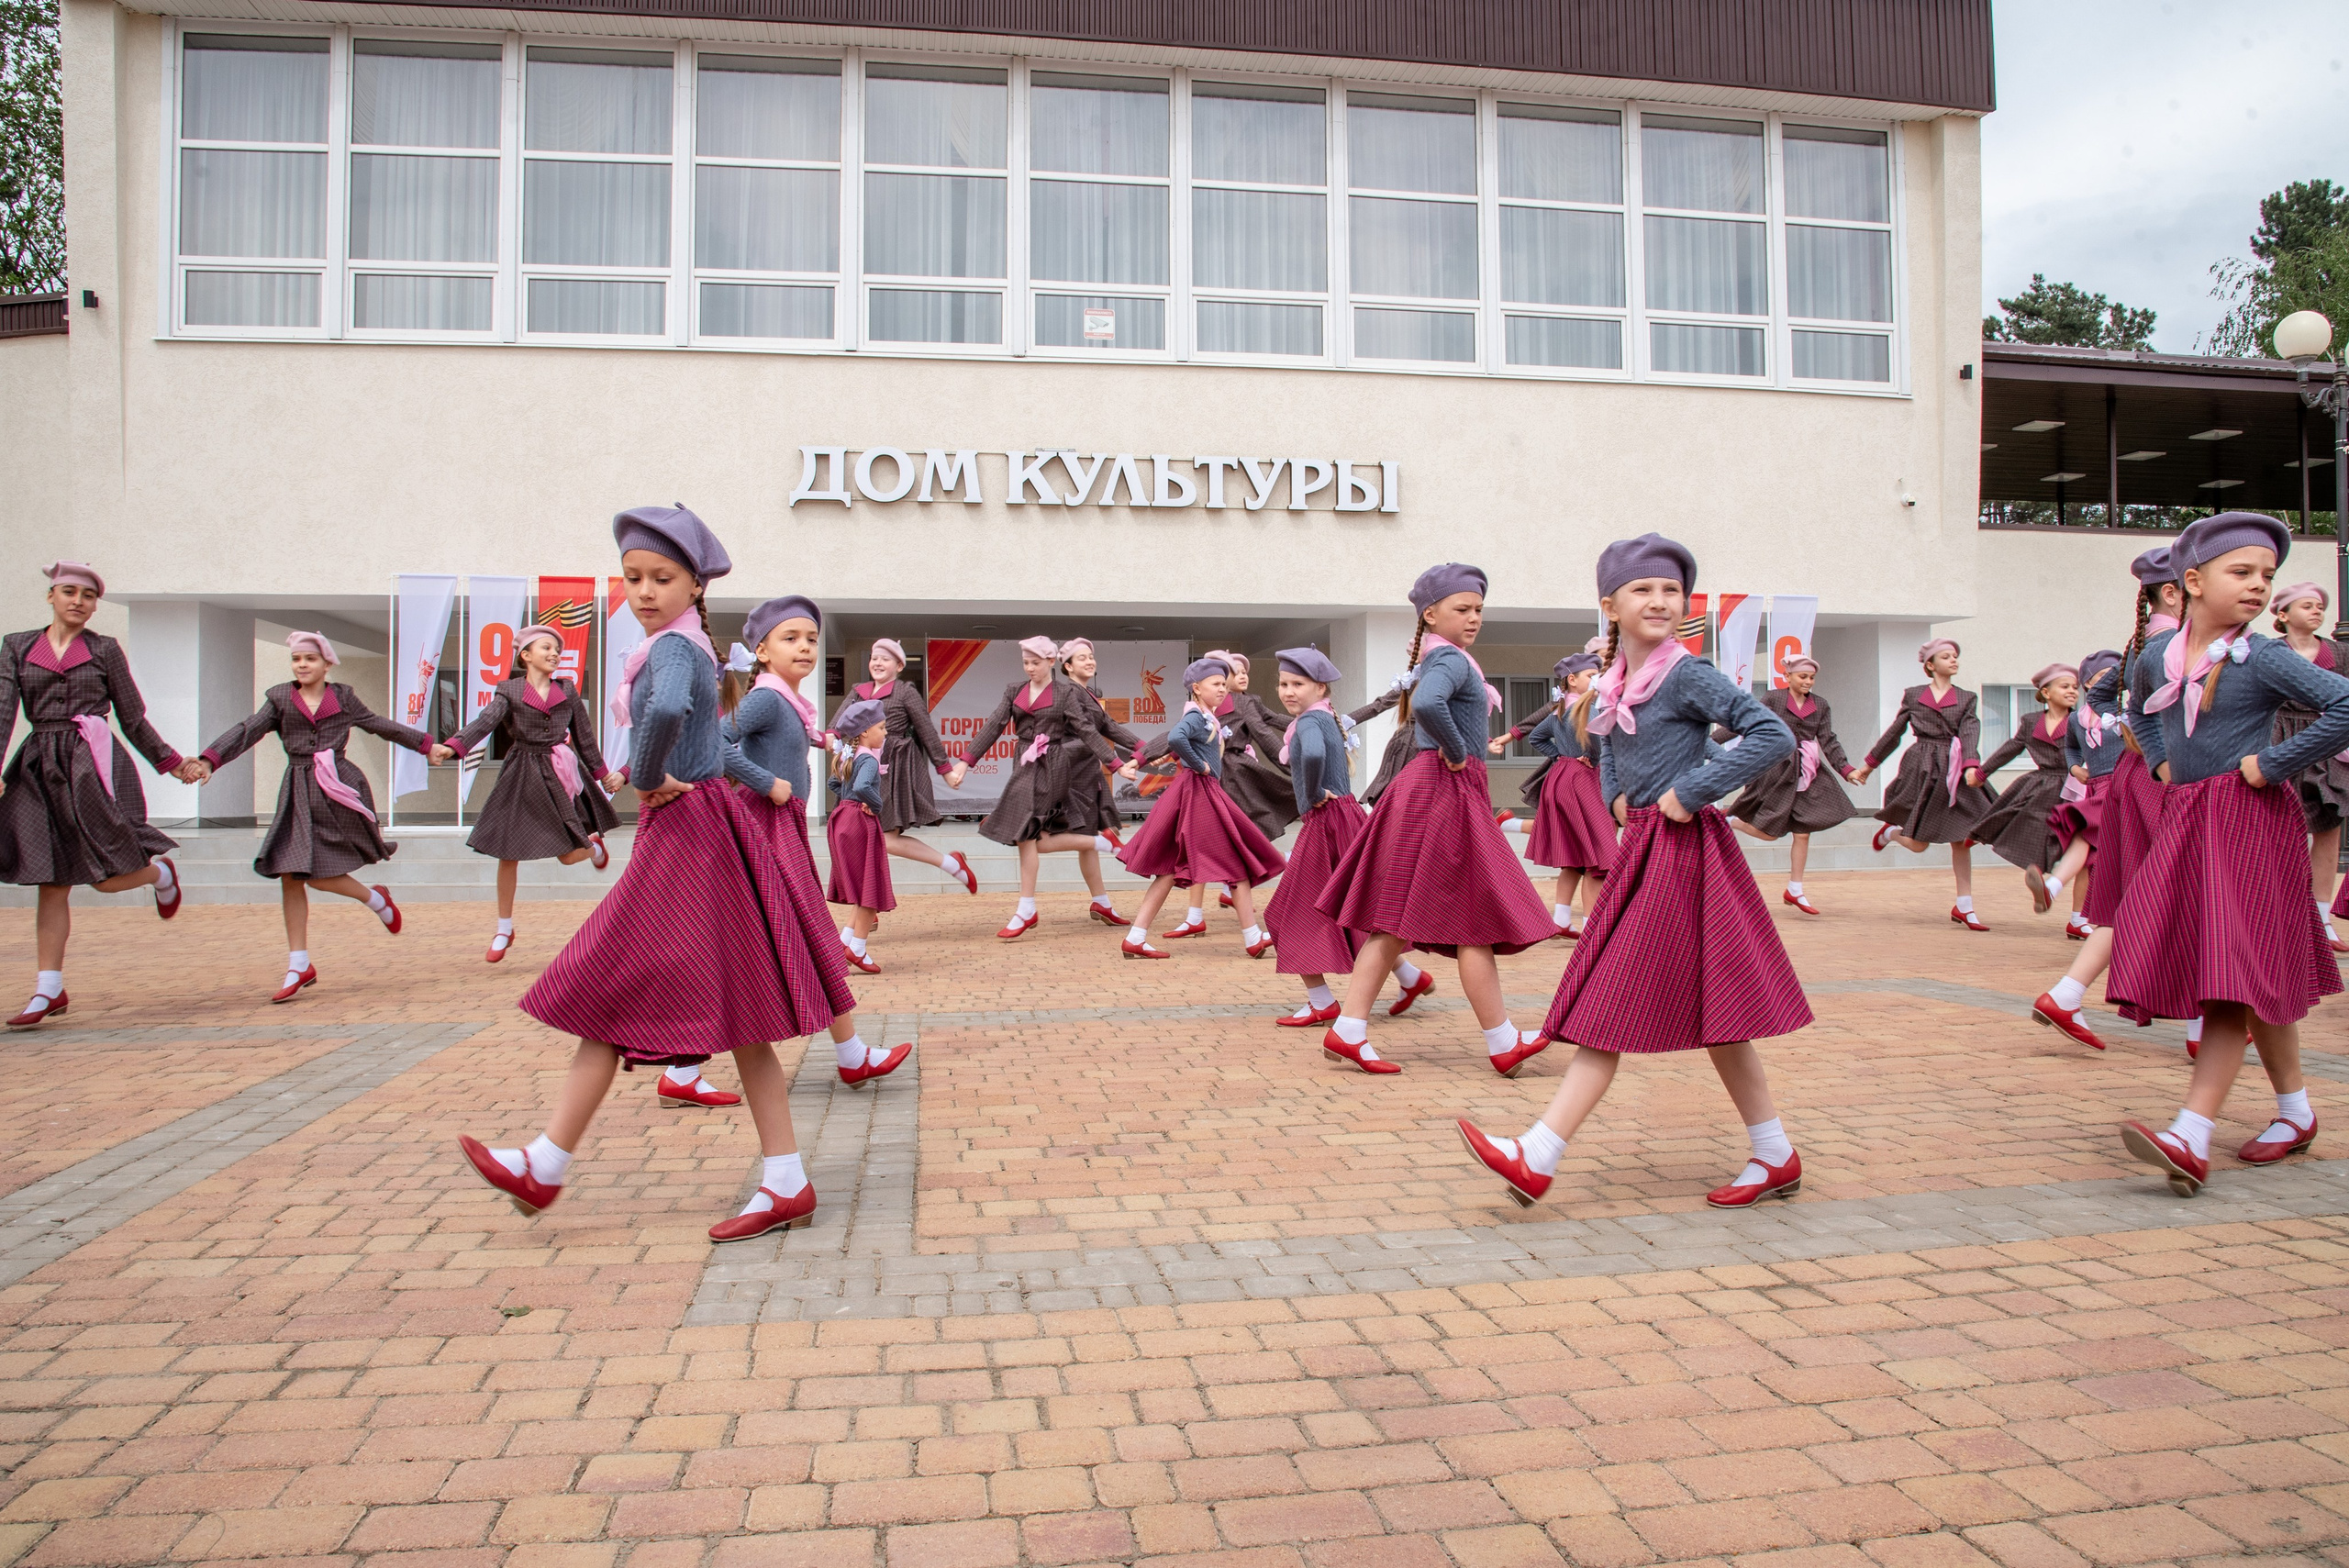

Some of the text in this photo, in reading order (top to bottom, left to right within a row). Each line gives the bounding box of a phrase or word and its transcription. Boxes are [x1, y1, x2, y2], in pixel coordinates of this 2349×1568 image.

[789, 445, 1400, 513] ДОМ КУЛЬТУРЫ
[480, 622, 514, 686] 9
[1133, 696, 1152, 713] 80
[1133, 715, 1166, 725] ПОБЕДА!
